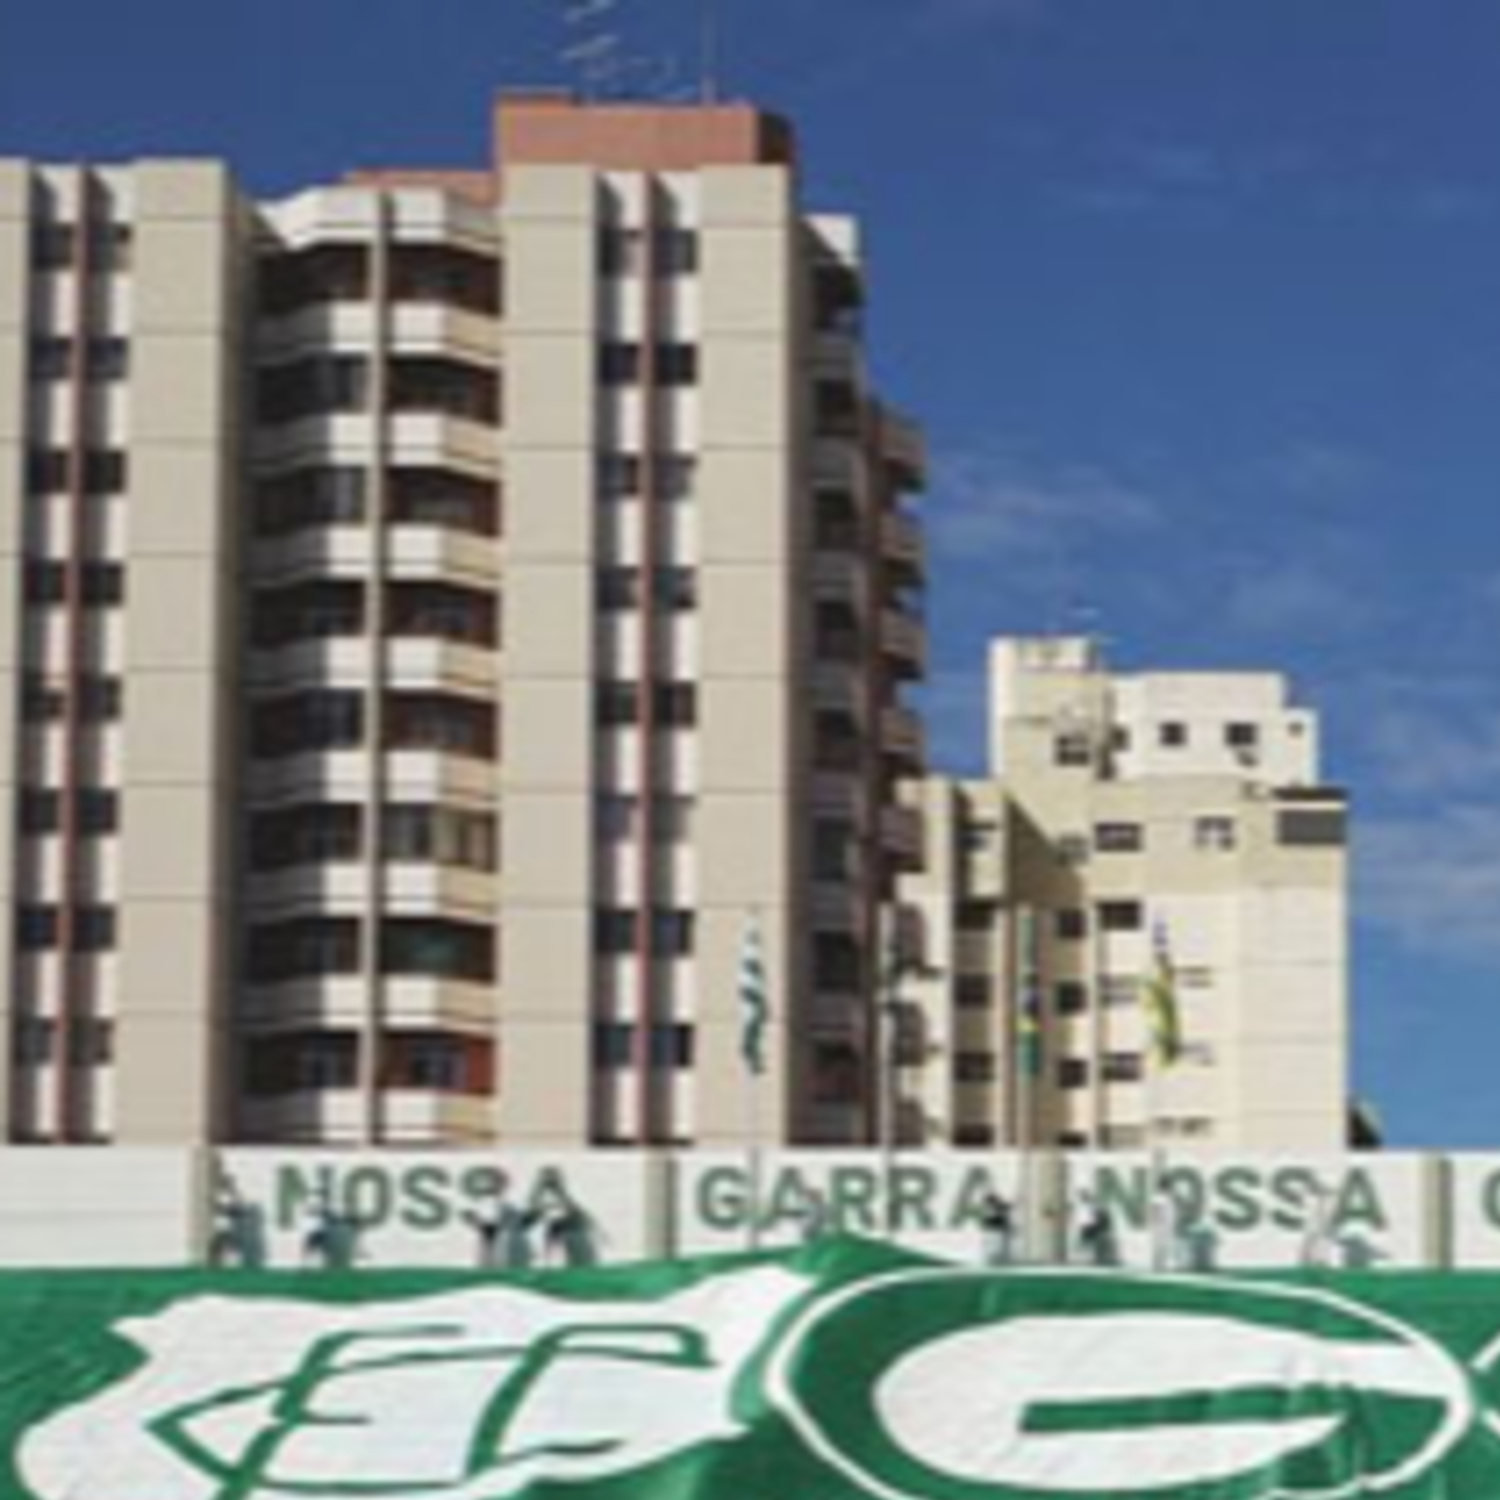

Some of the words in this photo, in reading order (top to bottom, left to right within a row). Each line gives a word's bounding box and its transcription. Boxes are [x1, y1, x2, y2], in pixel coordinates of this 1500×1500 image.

[275, 1165, 594, 1231] NOSSA
[695, 1165, 1006, 1231] GARRA
[1096, 1166, 1388, 1231] NOSSA
